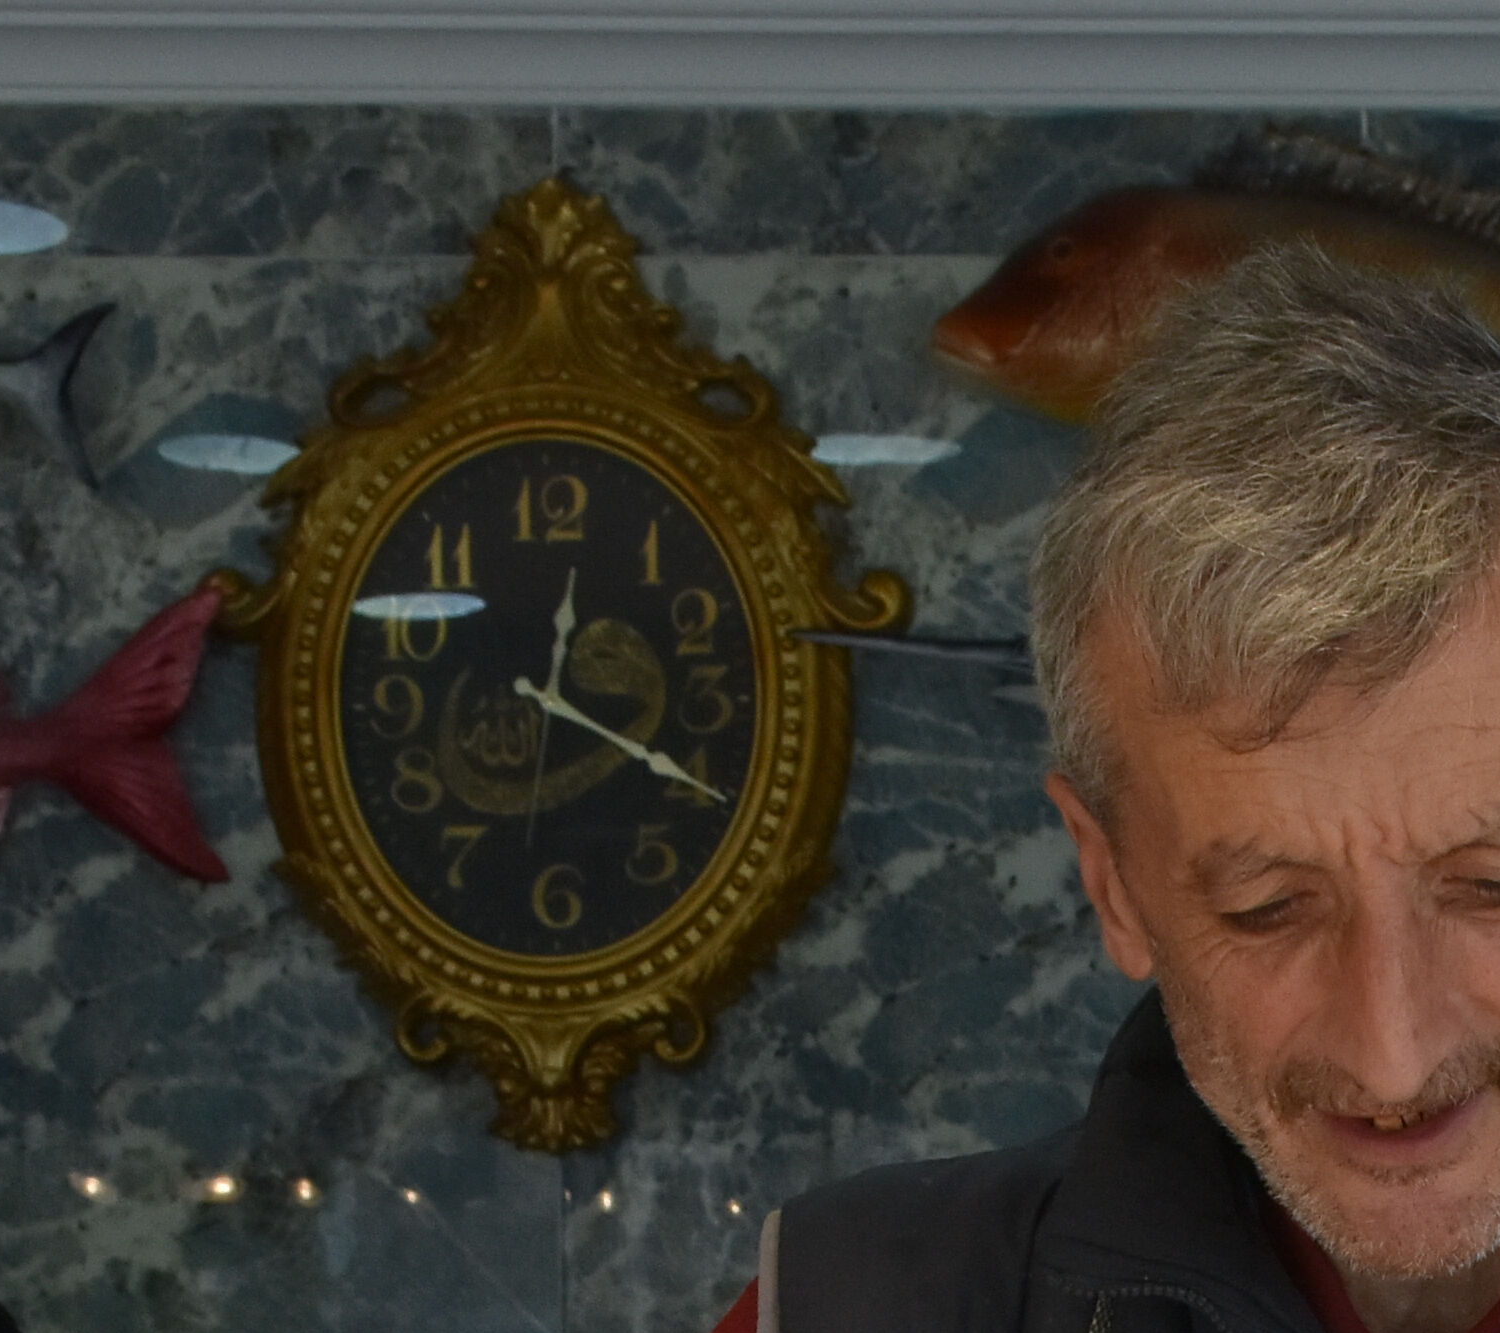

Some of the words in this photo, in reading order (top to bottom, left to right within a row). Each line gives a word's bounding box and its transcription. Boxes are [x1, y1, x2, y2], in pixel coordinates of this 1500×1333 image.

[513, 474, 588, 542] 12
[425, 522, 475, 589] 11
[639, 520, 663, 586] 1
[381, 596, 448, 662] 10
[671, 587, 720, 657] 2
[370, 675, 424, 739] 9
[675, 664, 735, 734] 3
[390, 748, 444, 813] 8
[664, 748, 716, 809] 4
[441, 824, 489, 889] 7
[624, 824, 679, 888] 5
[532, 864, 583, 930] 6
